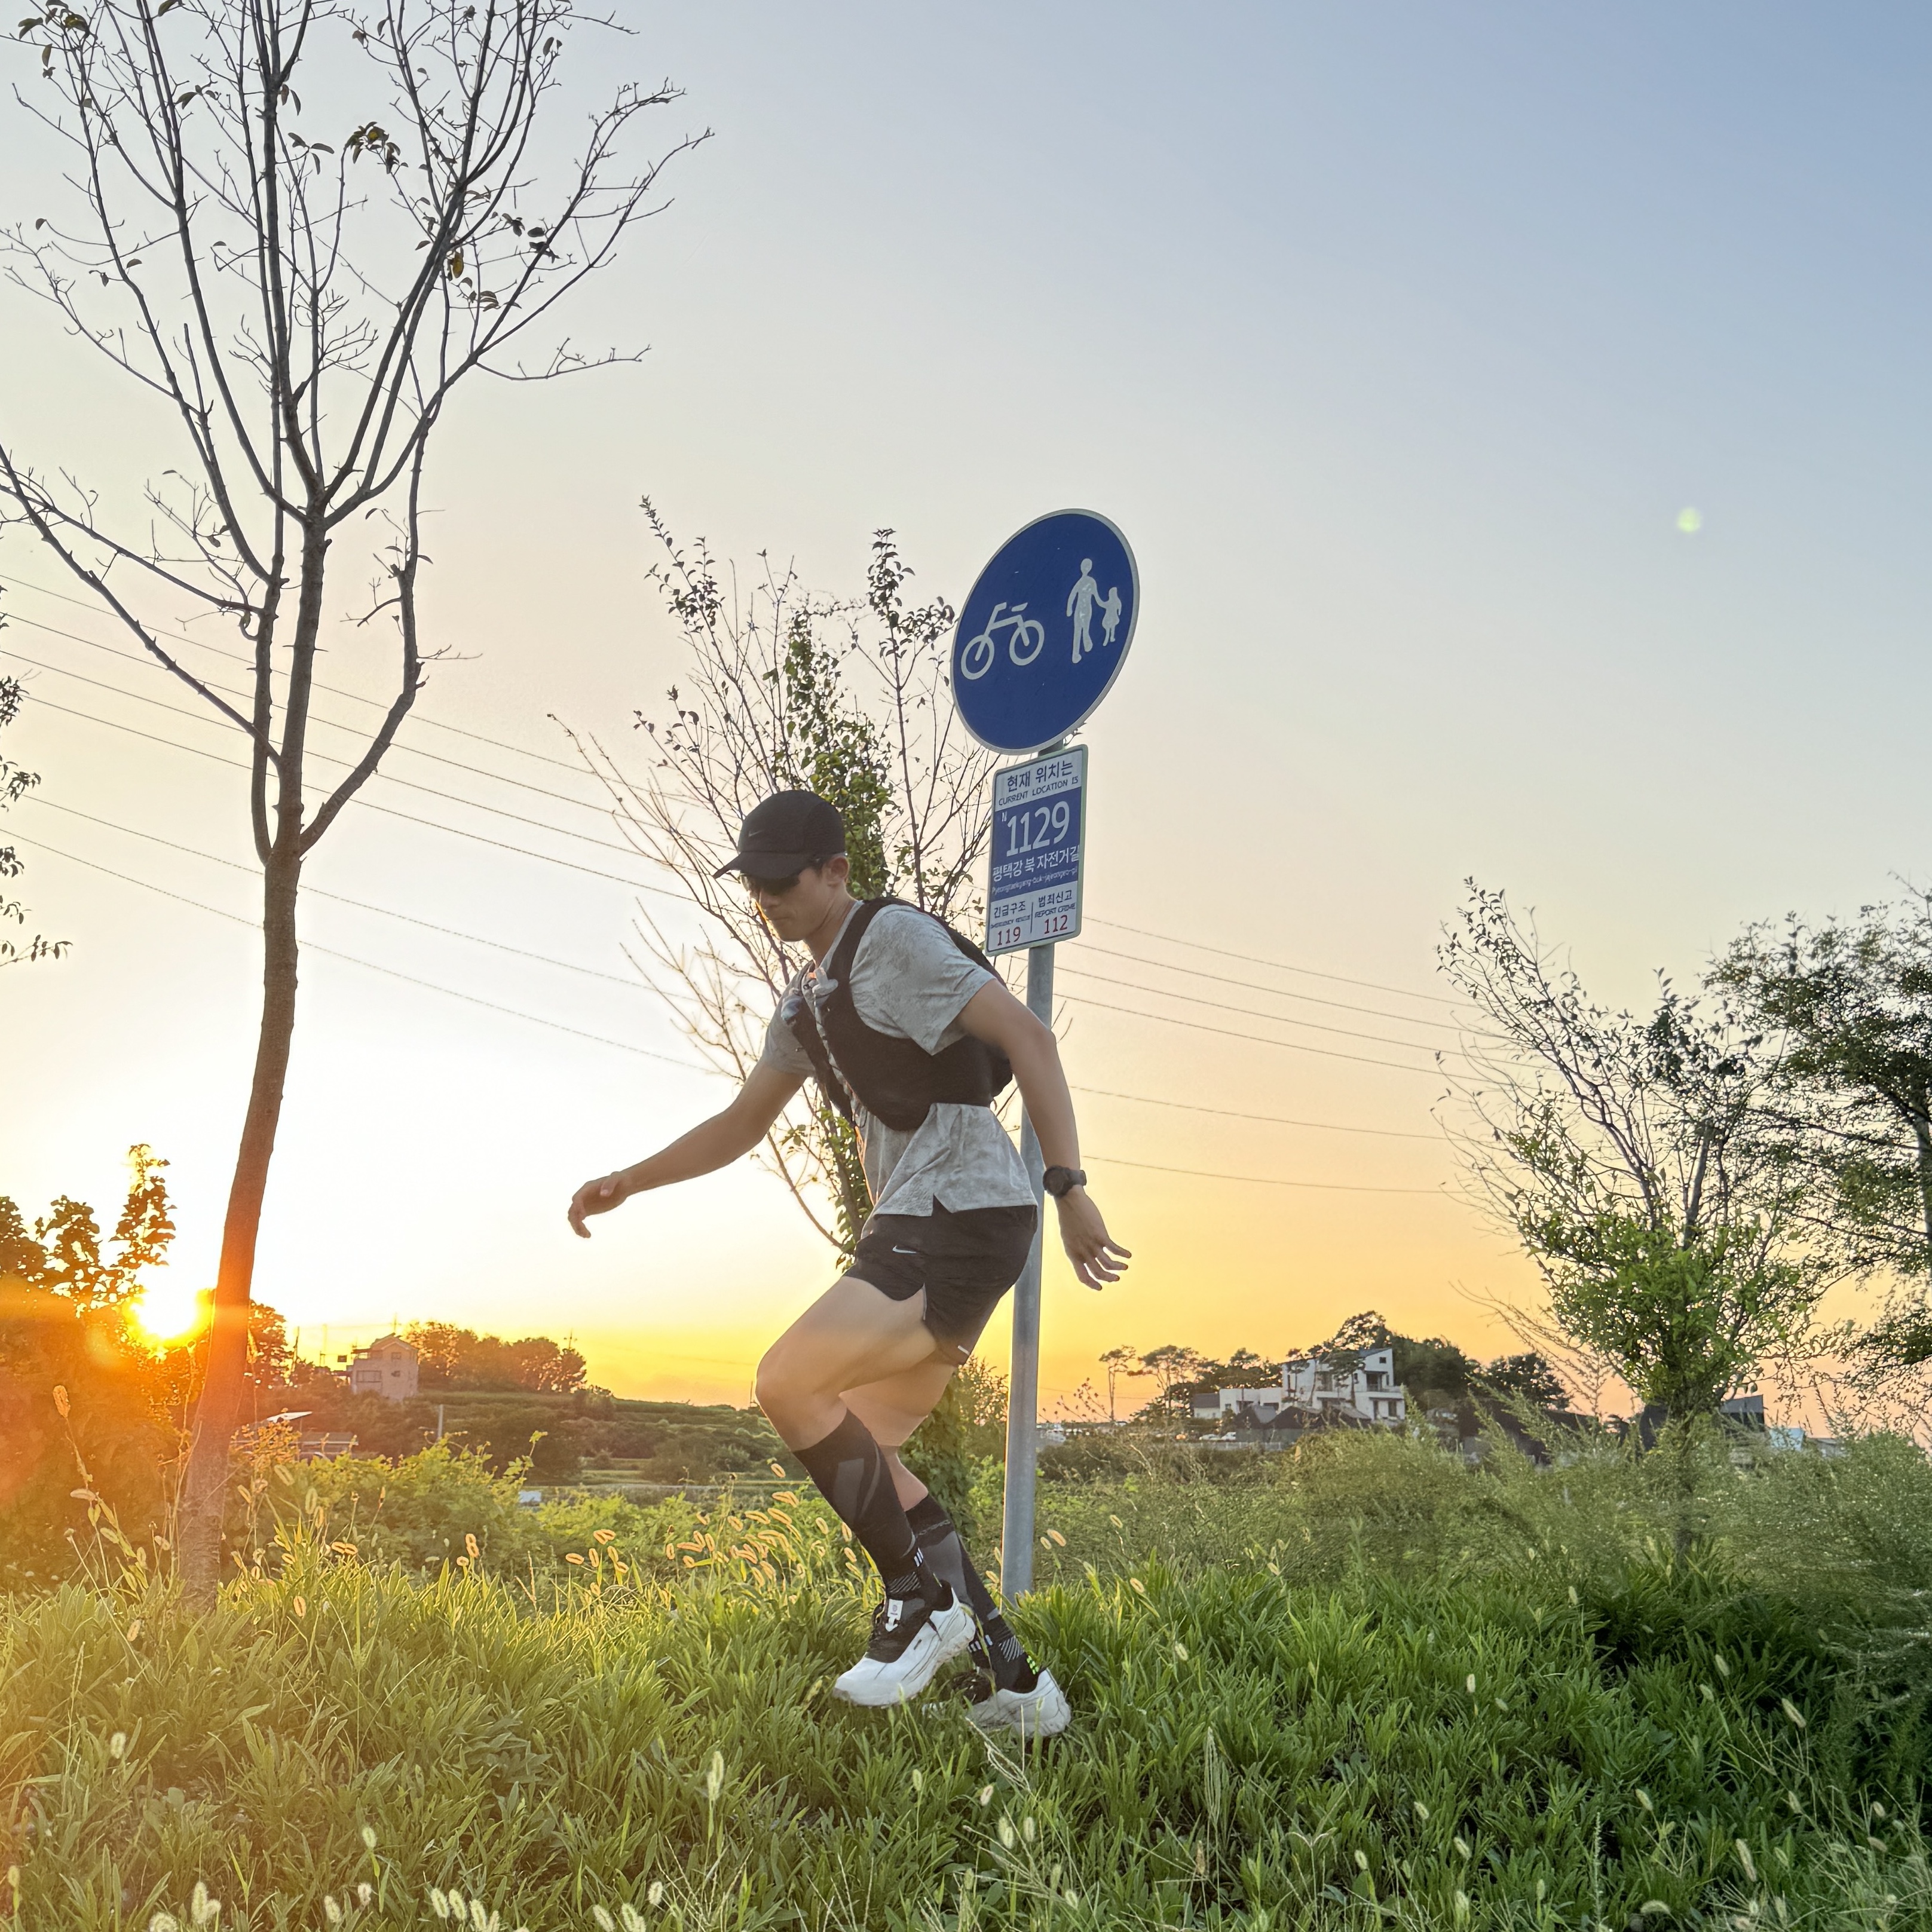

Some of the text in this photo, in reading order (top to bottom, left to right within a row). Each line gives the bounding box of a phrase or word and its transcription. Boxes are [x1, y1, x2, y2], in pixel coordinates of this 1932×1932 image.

[1008, 760, 1073, 792] 현재 위치는
[999, 776, 1079, 806] CURRENT LOCATION IS
[1006, 801, 1070, 857] 1129
[993, 845, 1079, 882] 평택강 북 자전거길
[994, 901, 1026, 918] 긴급구조
[1039, 890, 1072, 908] 범죄신고
[997, 926, 1021, 946] 119
[1044, 915, 1068, 935] 112
